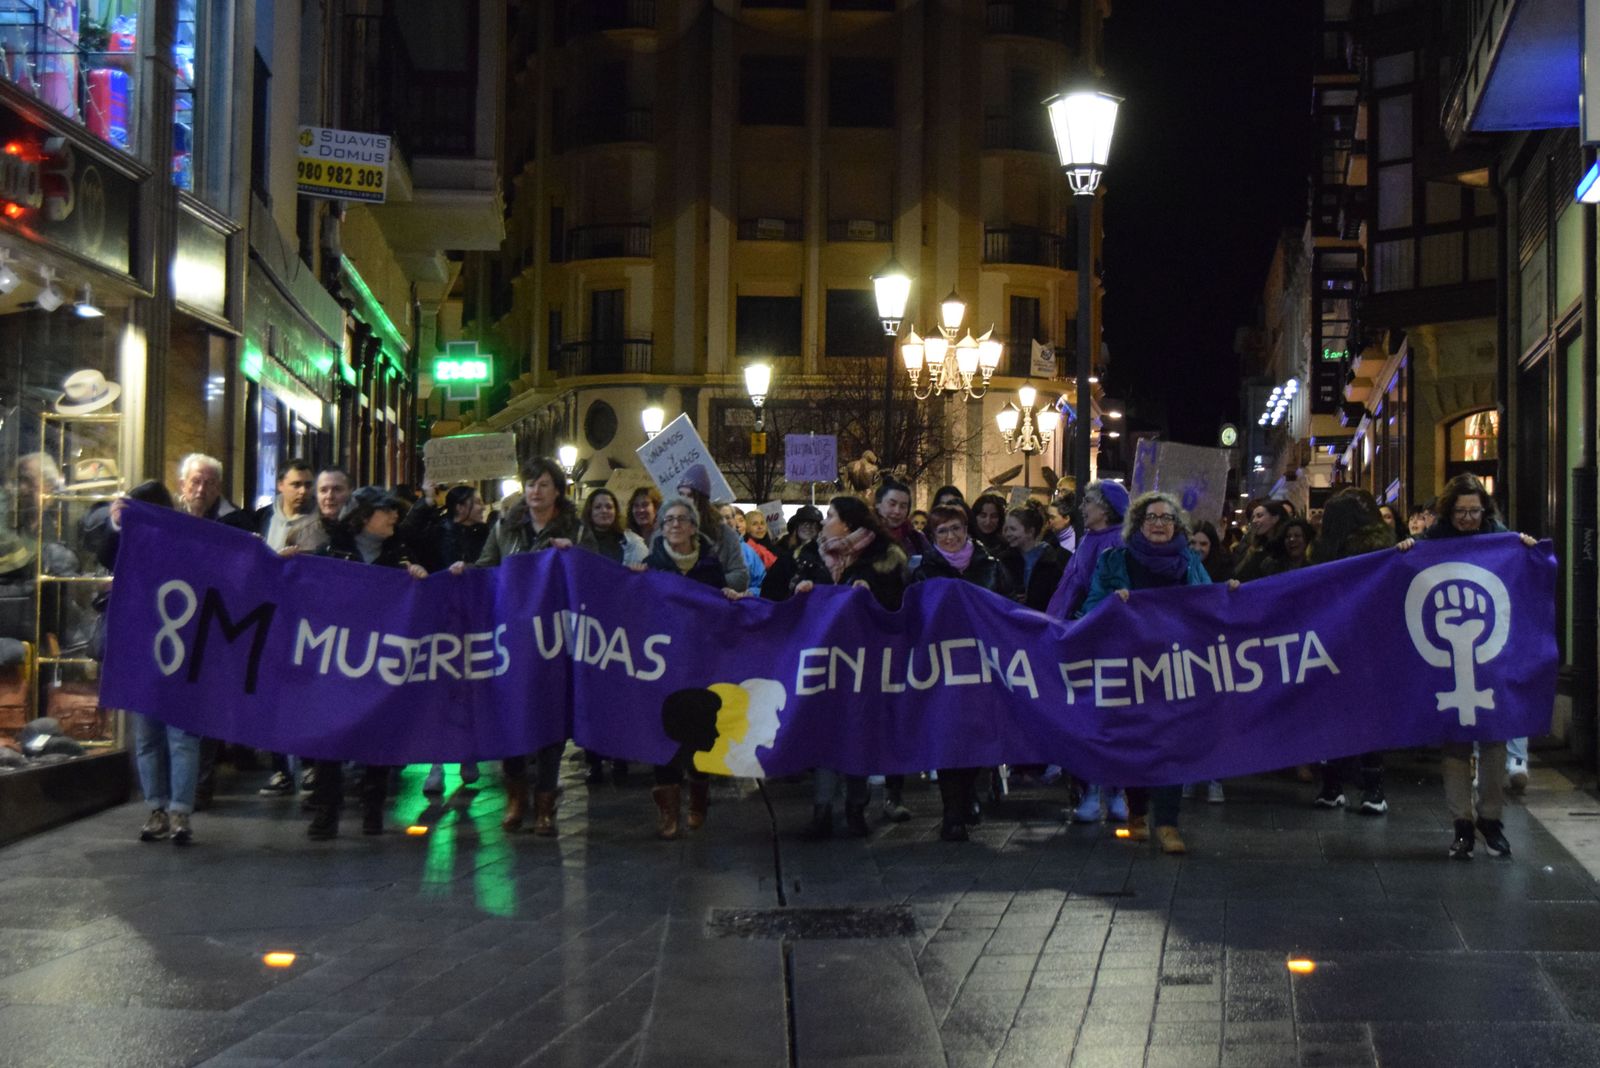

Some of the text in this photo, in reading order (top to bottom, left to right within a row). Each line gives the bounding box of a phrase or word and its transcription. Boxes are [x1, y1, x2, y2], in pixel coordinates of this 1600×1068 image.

[320, 129, 387, 149] SUAVIS
[319, 144, 385, 163] DOMUS
[297, 161, 383, 188] 980 982 303
[657, 447, 700, 484] ALCEMOS
[765, 511, 780, 522] NO
[154, 579, 276, 695] 8M
[294, 617, 510, 686] MUJERES
[796, 646, 866, 695] EN
[881, 637, 1039, 699] LUCHA
[1059, 630, 1341, 707] FEMINISTA
